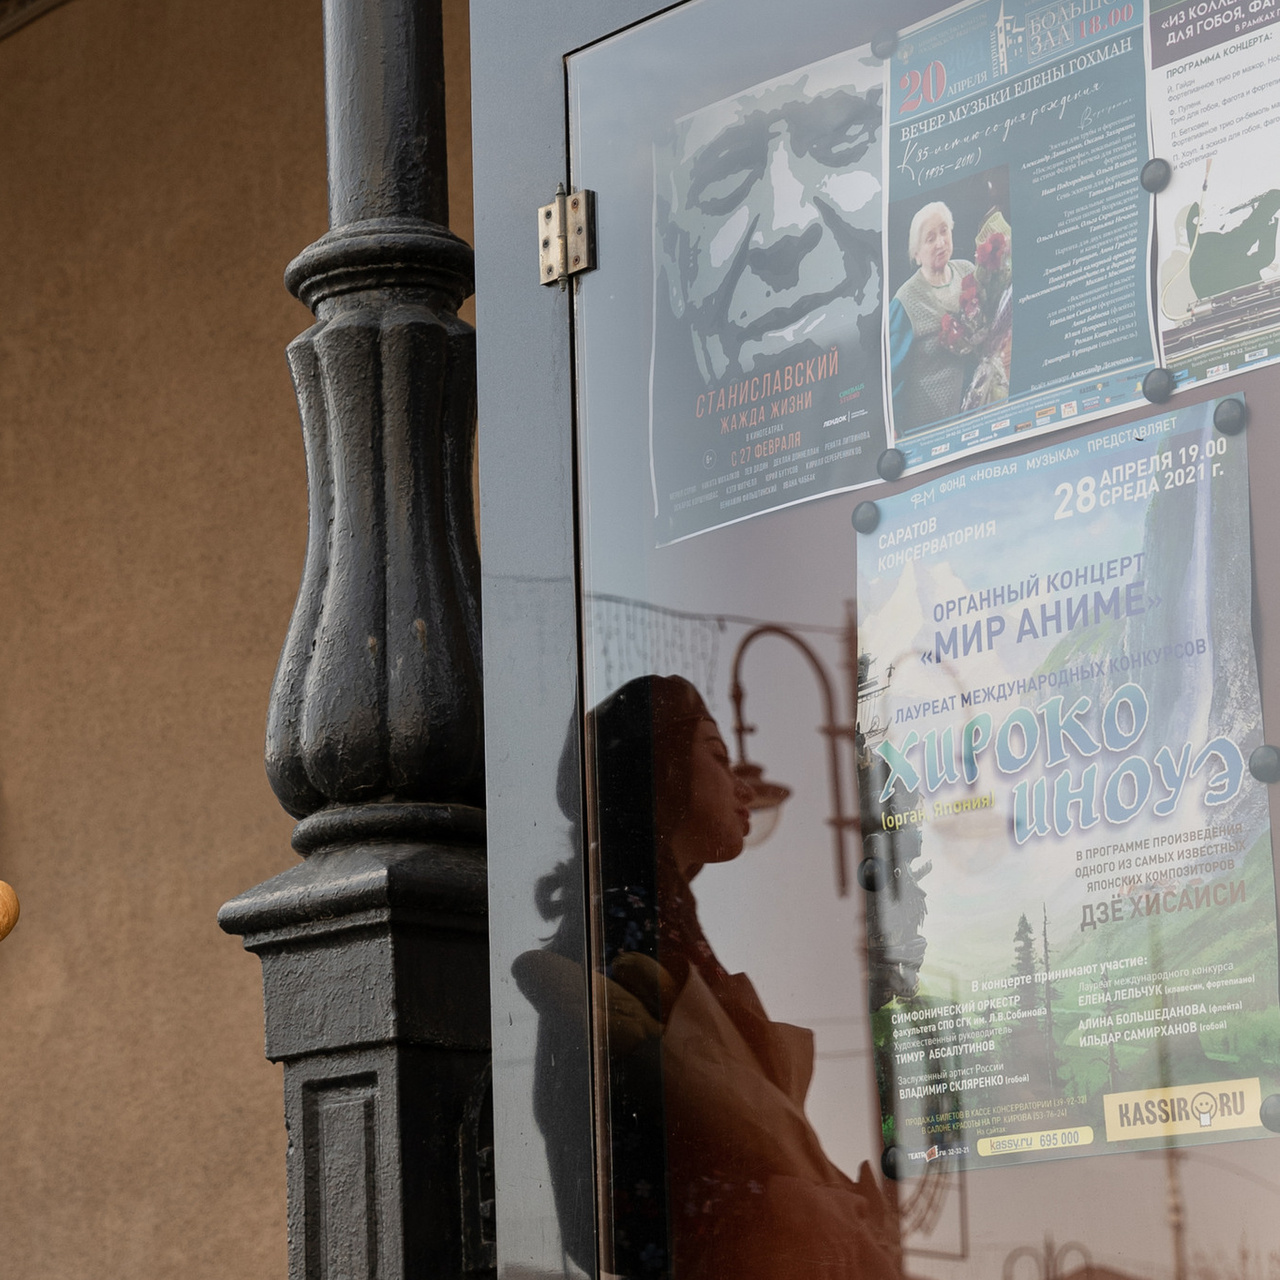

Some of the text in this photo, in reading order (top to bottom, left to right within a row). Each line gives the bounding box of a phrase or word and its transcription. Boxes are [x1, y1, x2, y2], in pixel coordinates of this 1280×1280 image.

[1080, 3, 1133, 39] 18.00
[1161, 11, 1185, 29] «ИЗ
[1166, 26, 1194, 46] ДЛЯ
[1196, 7, 1246, 32] ГОБОЯ,
[1234, 24, 1240, 32] В
[1241, 11, 1275, 29] РАМКАХ
[1030, 25, 1071, 56] ЗАЛ
[1166, 32, 1273, 79] ПРОГРАММА КОНЦЕРТА:
[898, 60, 988, 116] 20 АПРЕЛЯ
[900, 37, 1133, 142] ВЕЧЕР МУЗЫКИ ЕЛЕНЫ ГОХМАН
[1167, 80, 1214, 102] Фортепианное
[1216, 74, 1232, 85] трио
[1232, 70, 1241, 80] ре
[1175, 78, 1196, 92] Гайдн
[1179, 120, 1209, 137] Бетховен
[1187, 109, 1200, 122] для
[1171, 125, 1218, 148] Фортепианное
[1219, 119, 1235, 131] трио
[1228, 131, 1241, 142] для
[1178, 149, 1218, 170] фортепиано
[696, 346, 839, 419] СТАНИСЛАВСКИЙ
[720, 390, 813, 435] ЖАЖДА ЖИЗНИ
[731, 431, 801, 467] С 27 ФЕВРАЛЯ
[750, 424, 784, 441] КИНОТЕАТРАХ
[939, 416, 1177, 494] ФОНД «НОВАЯ МУЗЫКА» ПРЕДСТАВЛЯЕТ
[1054, 437, 1227, 520] 28 АПРЕЛЯ 19.00
[1099, 463, 1224, 507] СРЕДА 2021 г.
[878, 516, 937, 550] САРАТОВ
[878, 520, 997, 572] КОНСЕРВАТОРИЯ
[933, 552, 1145, 622] ОРГАННЫЙ КОНЦЕРТ
[920, 580, 1162, 665] «МИР АНИМЕ»
[895, 638, 1207, 724] ЛАУРЕАТ МЕЖДУНАРОДНЫХ КОНКУРСОВ
[876, 682, 1150, 803] ХИРОКО
[1012, 736, 1245, 844] ИНОУЭ
[881, 791, 995, 830] (орган, Япония)
[1076, 823, 1243, 861] В ПРОГРАММЕ ПРОИЗВЕДЕНИЯ
[1075, 840, 1247, 879] ОДНОГО ИЗ САМЫХ ИЗВЕСТНЫХ
[1086, 859, 1235, 893] ЯПОНСКИХ КОМПОЗИТОРОВ
[1080, 879, 1246, 932] ДЗЁ ХИСАИСИ
[971, 955, 1148, 992] В концерте принимают участие:
[1077, 961, 1234, 993] Лауреат международного конкурса
[1078, 991, 1112, 1007] ЕЛЕНА
[1113, 984, 1163, 1001] ЛЕЛЬЧУК
[1206, 973, 1255, 990] фортепиано)
[891, 995, 1021, 1025] СИМФОНИЧЕСКИЙ ОРКЕСТР
[1078, 1000, 1243, 1031] АЛИНА БОЛЬШЕДАНОВА (флейта)
[892, 1023, 937, 1040] факультета
[937, 1020, 954, 1031] СПО
[955, 1018, 972, 1027] СГК
[893, 1026, 1013, 1051] Художественный руководитель
[1079, 1019, 1228, 1047] ИЛЬДАР САМИРХАНОВ (гобой)
[895, 1040, 996, 1065] ТИМУР АБСАЛУТИНОВ
[897, 1063, 1004, 1086] Заслуженный артист России
[899, 1073, 1030, 1100] ВЛАДИМИР СКЛЯРЕНКО (гобой)
[927, 1123, 952, 1134] САЛОНЕ
[1003, 1112, 1032, 1124] КИРОВА
[935, 1111, 965, 1123] БИЛЕТОВ
[970, 1106, 991, 1117] КАССЕ
[992, 1099, 1053, 1114] КОНСЕРВАТОРИИ
[990, 1130, 1079, 1151] kassy.ru 695 000
